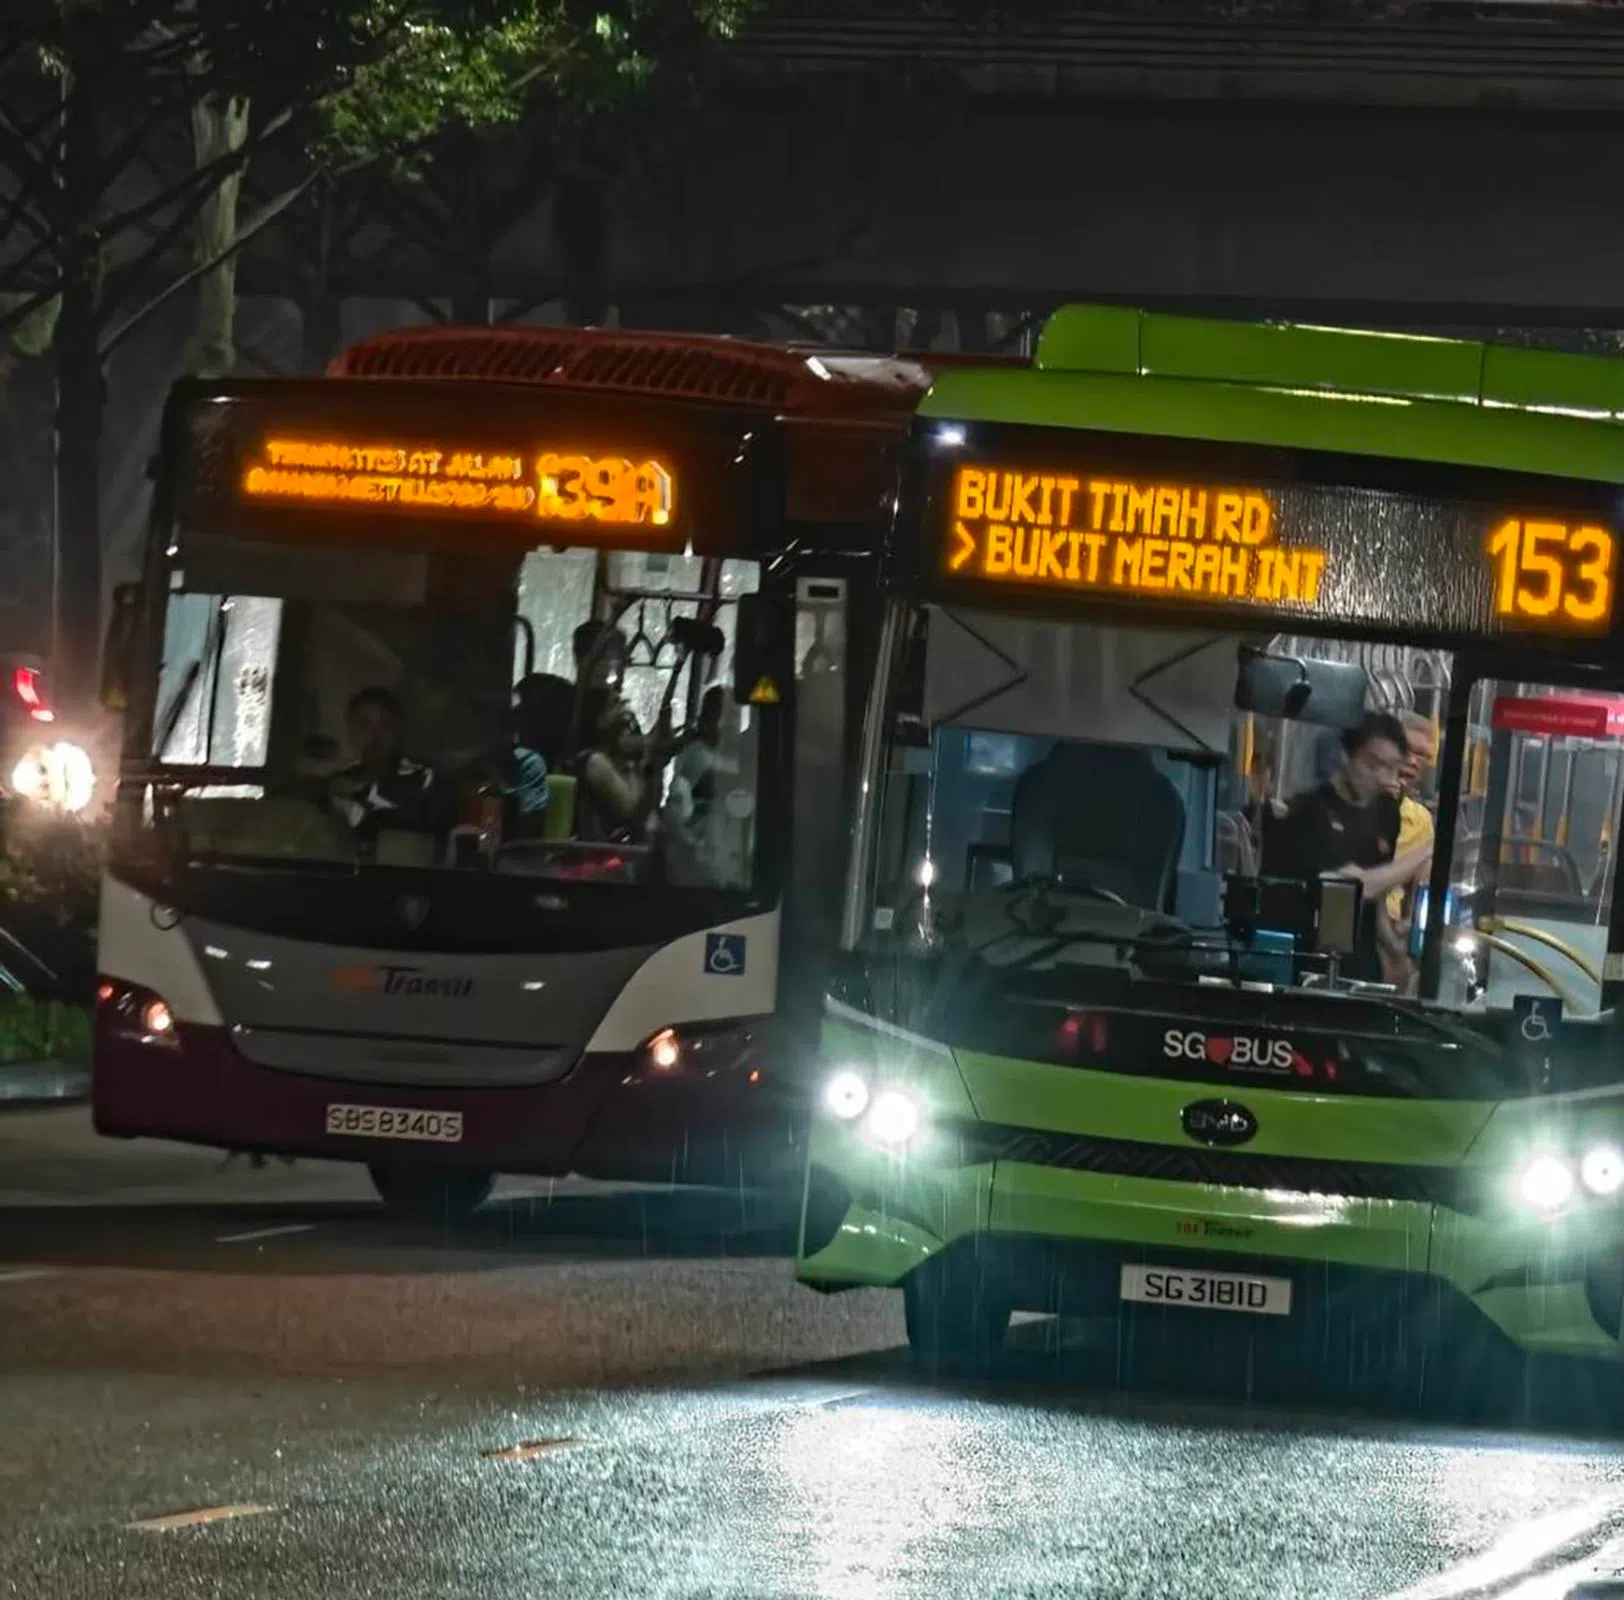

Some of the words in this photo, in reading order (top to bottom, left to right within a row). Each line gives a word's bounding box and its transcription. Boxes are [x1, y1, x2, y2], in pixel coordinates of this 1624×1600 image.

[958, 469, 1079, 527] BUKIT
[1089, 481, 1206, 540] TIMAH
[1215, 493, 1271, 545] RD
[984, 524, 1105, 582] BUKIT
[1112, 537, 1247, 599] MERAH
[1255, 549, 1324, 602] INT
[1490, 519, 1612, 620] 153
[1163, 1029, 1207, 1060] SG
[1230, 1036, 1293, 1068] BUS
